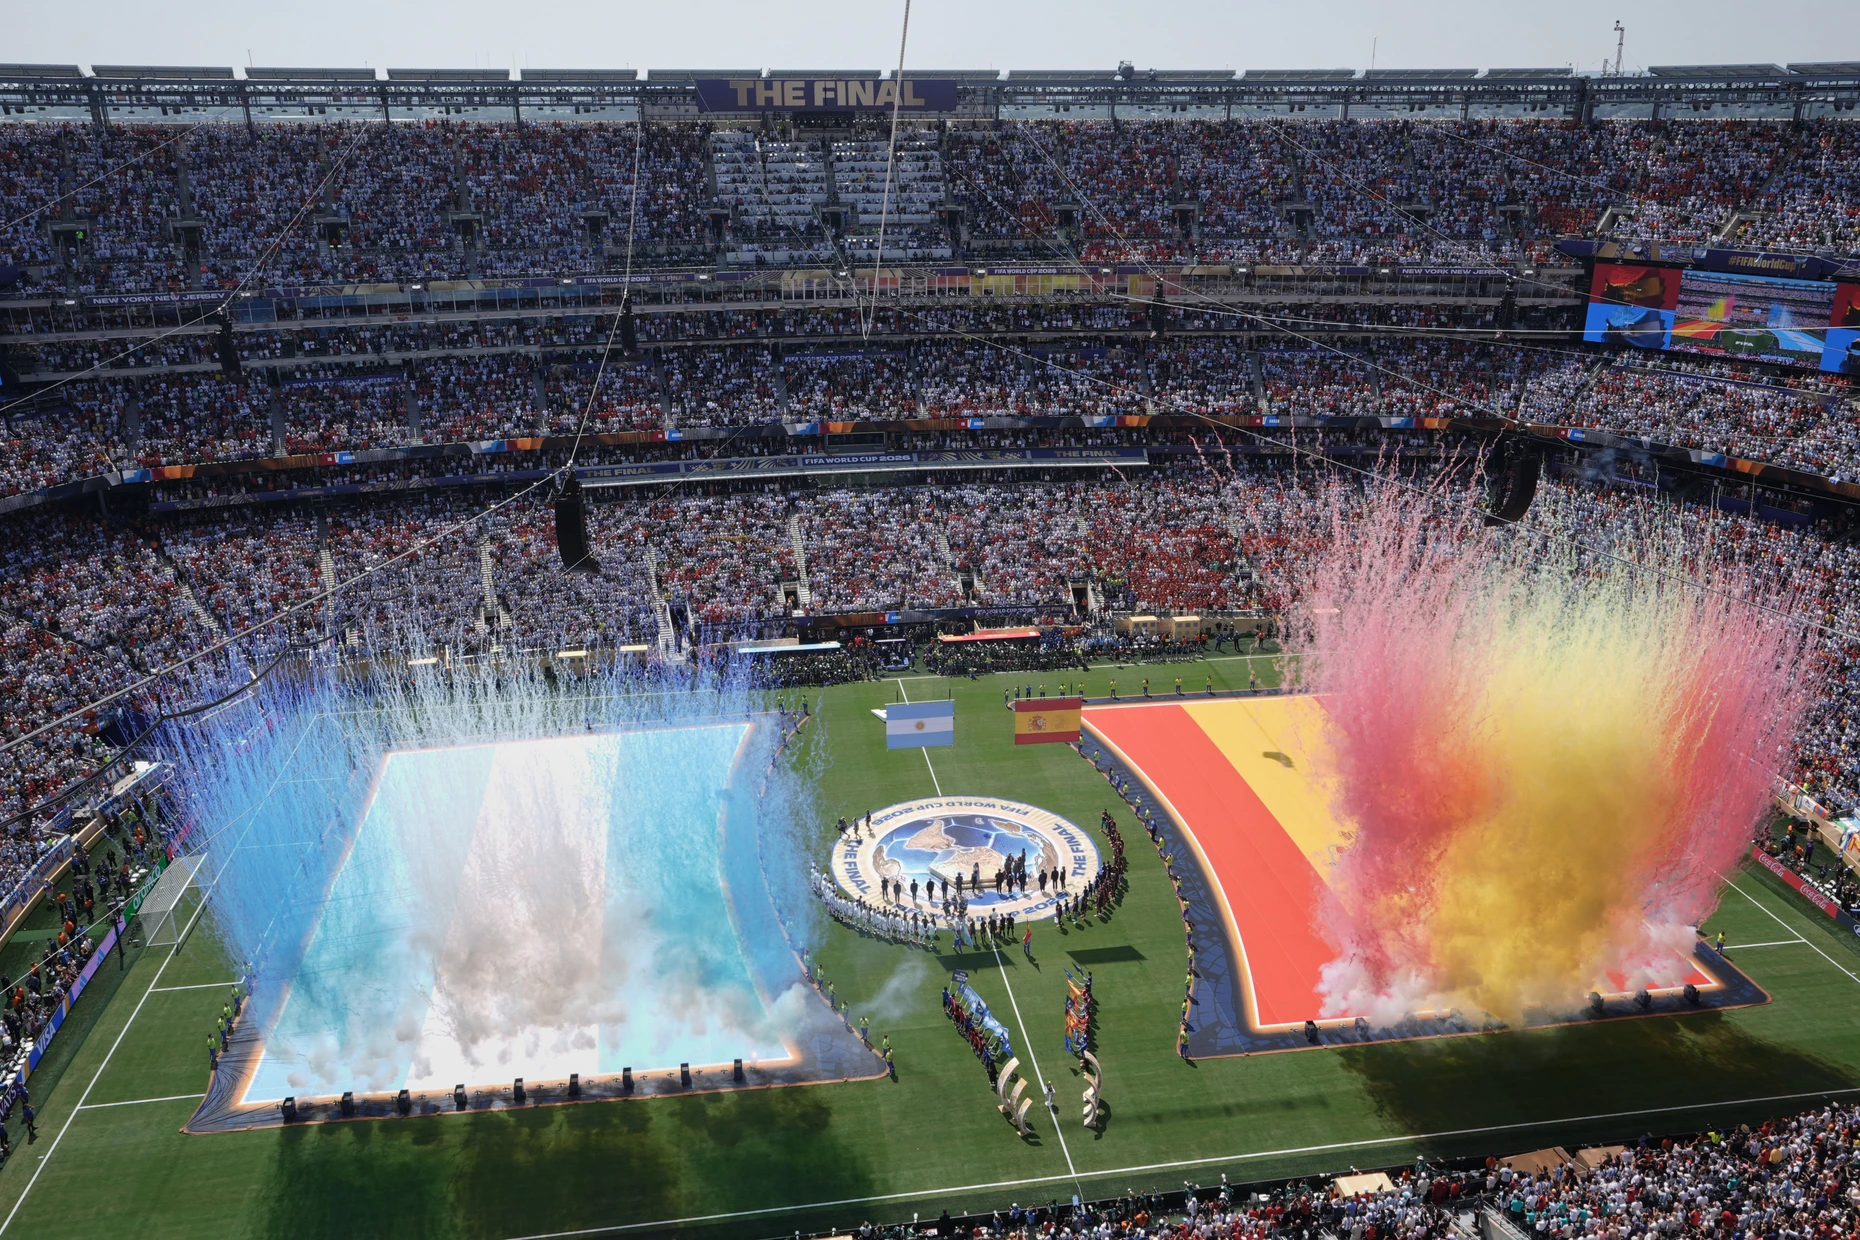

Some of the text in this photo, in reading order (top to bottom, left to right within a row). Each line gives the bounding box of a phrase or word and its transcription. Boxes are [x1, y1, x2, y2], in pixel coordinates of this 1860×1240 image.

[729, 80, 925, 107] THE FINAL
[1472, 268, 1509, 276] JERSEY
[93, 297, 119, 305] NEW
[155, 294, 180, 302] NEW
[182, 293, 225, 301] JERSEY
[584, 467, 656, 477] THE FINAL
[871, 801, 1029, 825] FIFA WORLD CUP 2026
[1052, 823, 1087, 877] THE FINAL
[844, 839, 871, 894] THE FINAL
[133, 865, 161, 910] aramco
[1022, 892, 1069, 915] 2026
[36, 1022, 56, 1055] VISA
